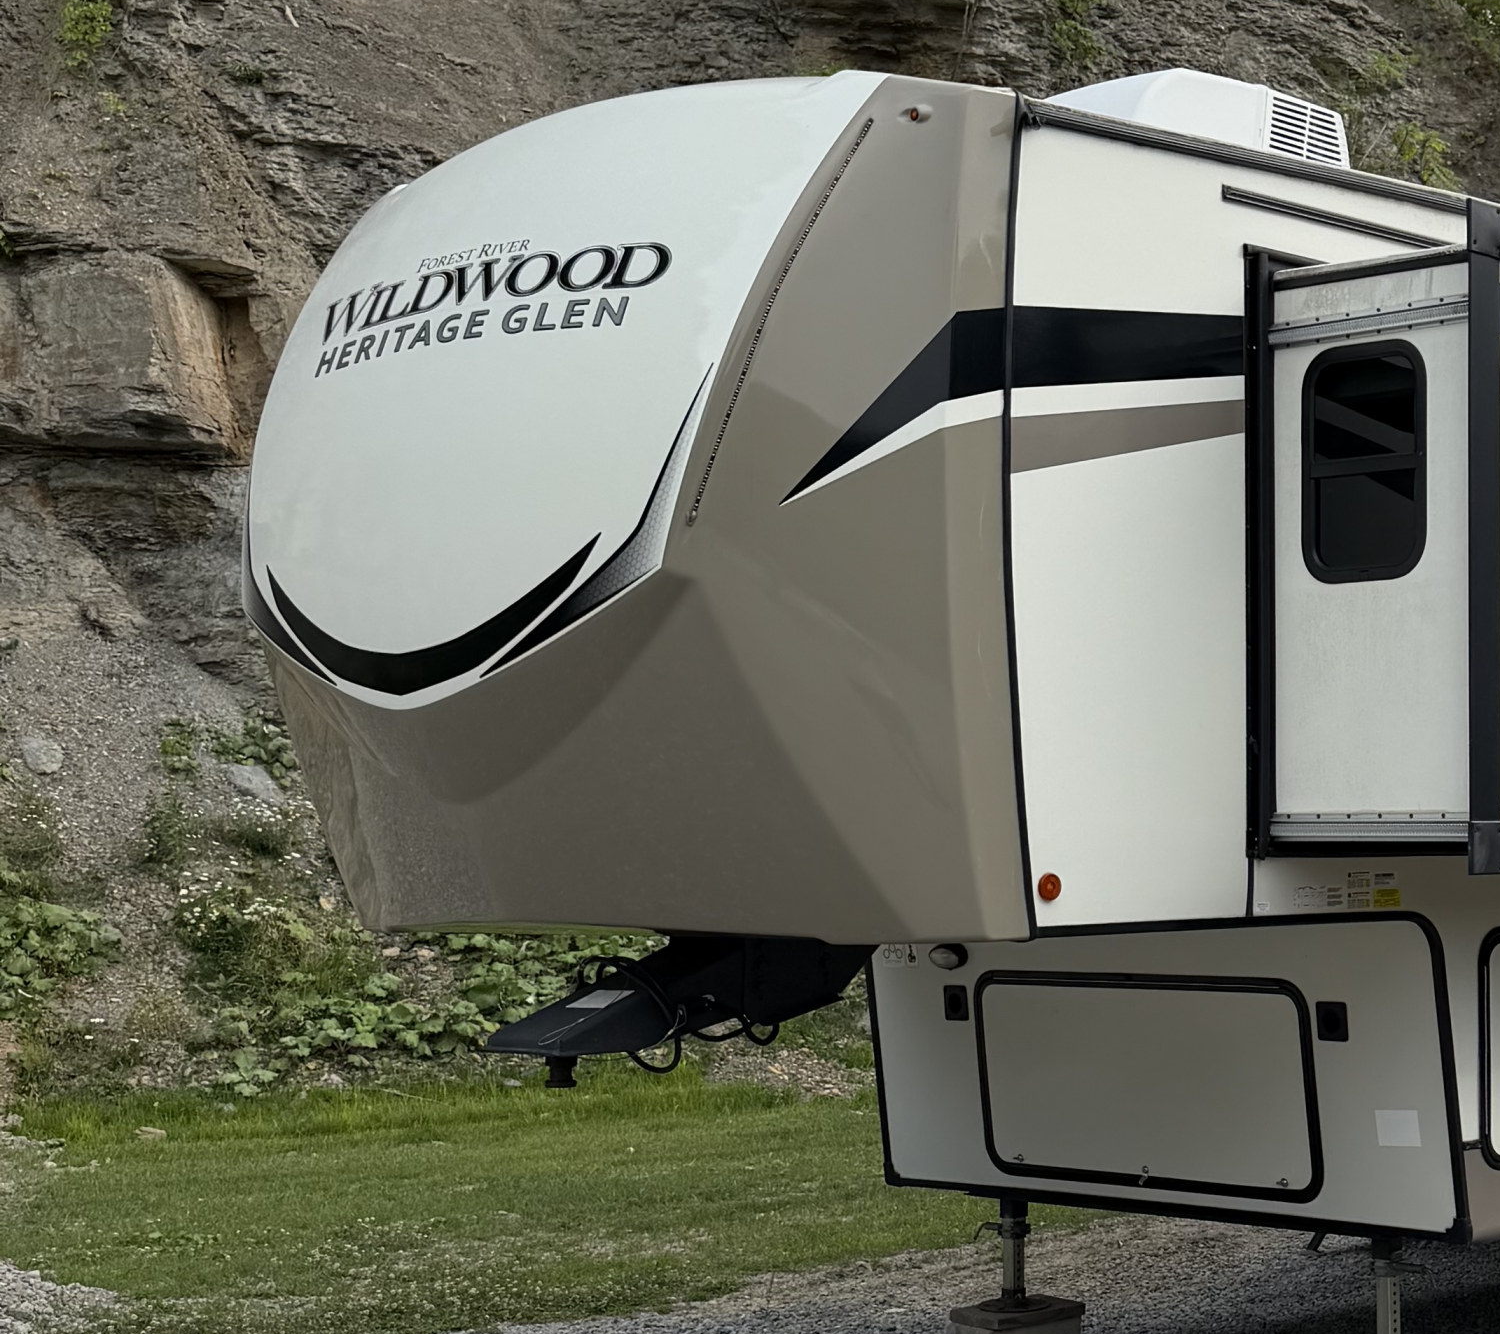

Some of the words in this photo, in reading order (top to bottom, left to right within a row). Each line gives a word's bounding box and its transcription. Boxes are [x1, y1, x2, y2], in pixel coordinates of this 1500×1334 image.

[322, 241, 673, 346] WILDWOOD
[416, 248, 477, 274] FOREST
[478, 238, 531, 260] RIVER
[314, 308, 490, 379] HERITAGE
[501, 295, 630, 335] GLEN
